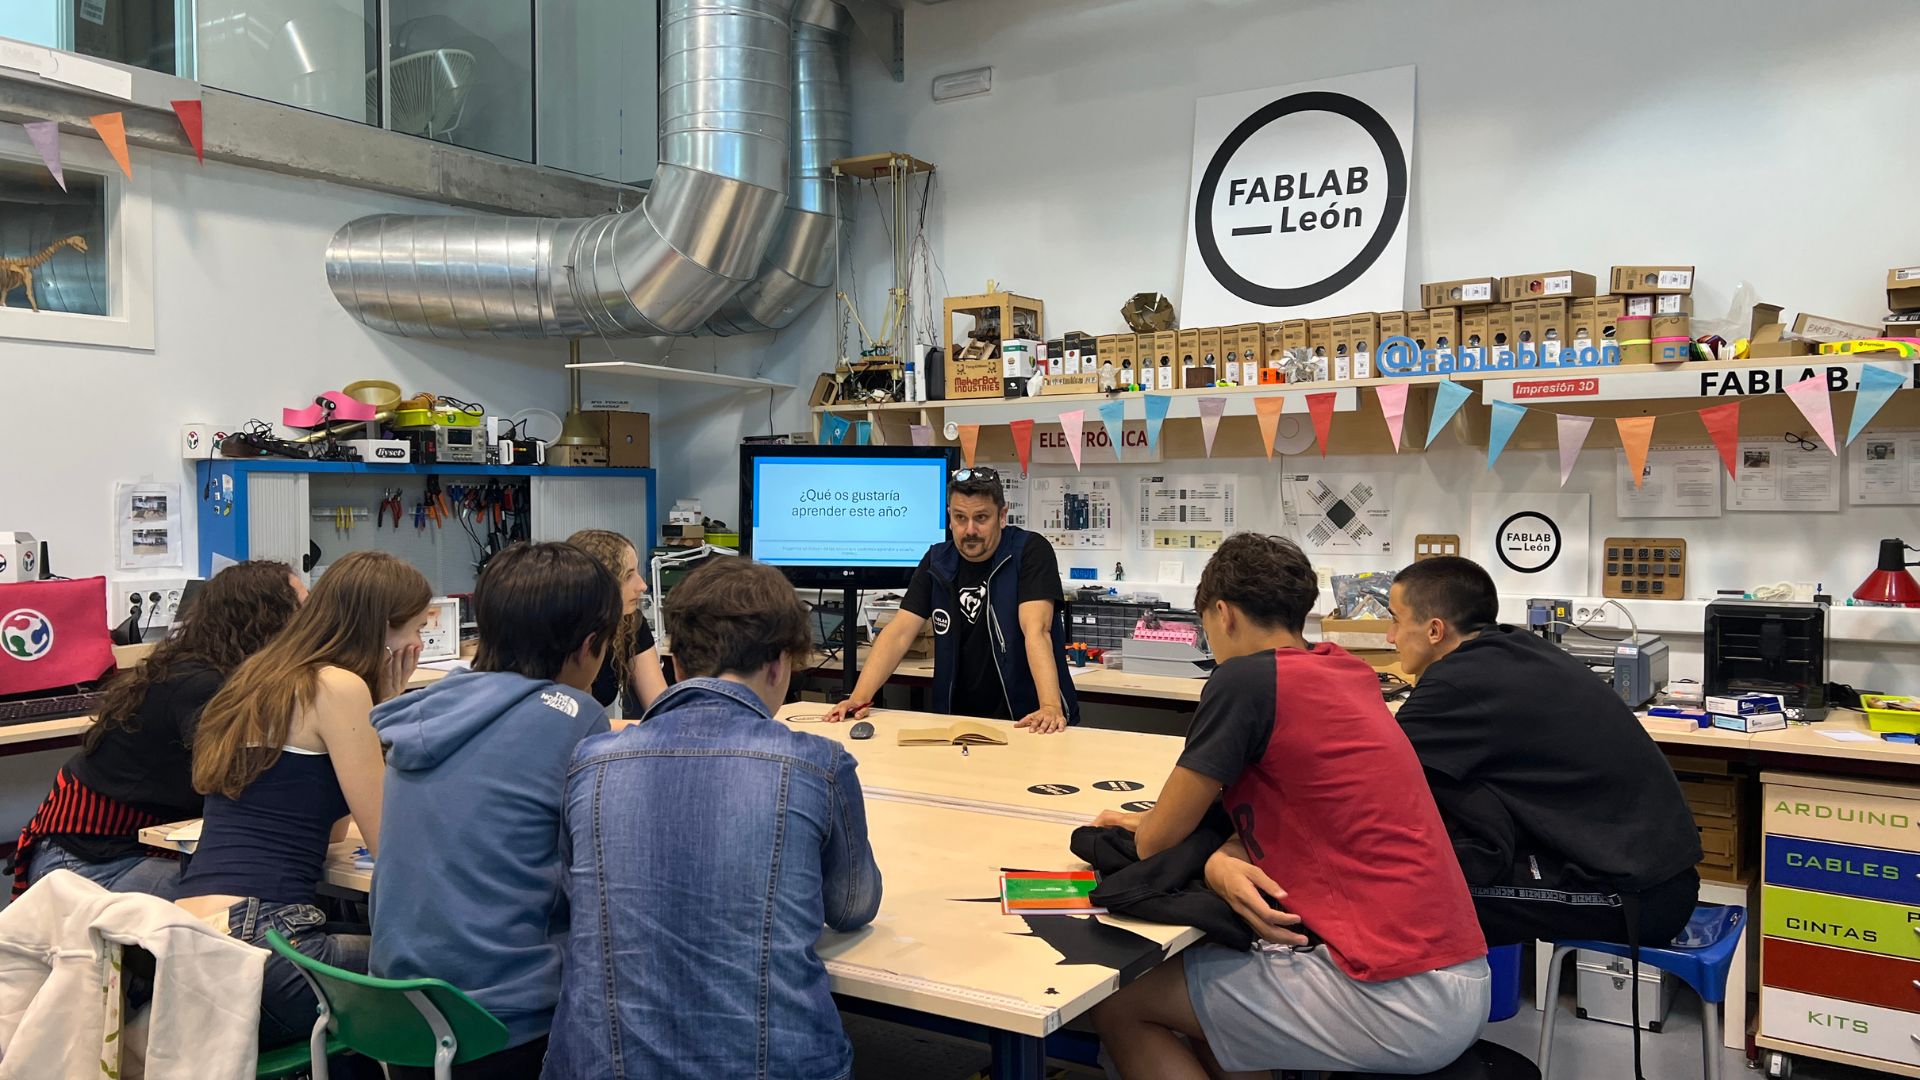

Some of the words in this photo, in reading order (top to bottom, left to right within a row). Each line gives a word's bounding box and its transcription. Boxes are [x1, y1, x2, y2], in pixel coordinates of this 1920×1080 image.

[1228, 166, 1369, 206] FABLAB
[1280, 201, 1363, 233] León
[954, 375, 1000, 387] MakerBot
[954, 384, 1000, 393] INDUSTRIES
[1516, 382, 1575, 395] Impresión
[1578, 381, 1595, 391] 3D
[1040, 426, 1148, 448] ELERÓICA
[799, 488, 831, 503] ¿Qué
[834, 491, 849, 501] os
[851, 488, 901, 503] gustaría
[791, 506, 846, 519] aprender
[849, 506, 875, 517] este
[878, 505, 908, 518] año?
[1506, 532, 1551, 542] FABLAB
[1524, 543, 1550, 551] León
[1774, 800, 1909, 829] ARDUINO
[1786, 852, 1899, 880] CABLES
[1786, 917, 1878, 943] CINTAS
[1808, 1011, 1869, 1034] KITS
